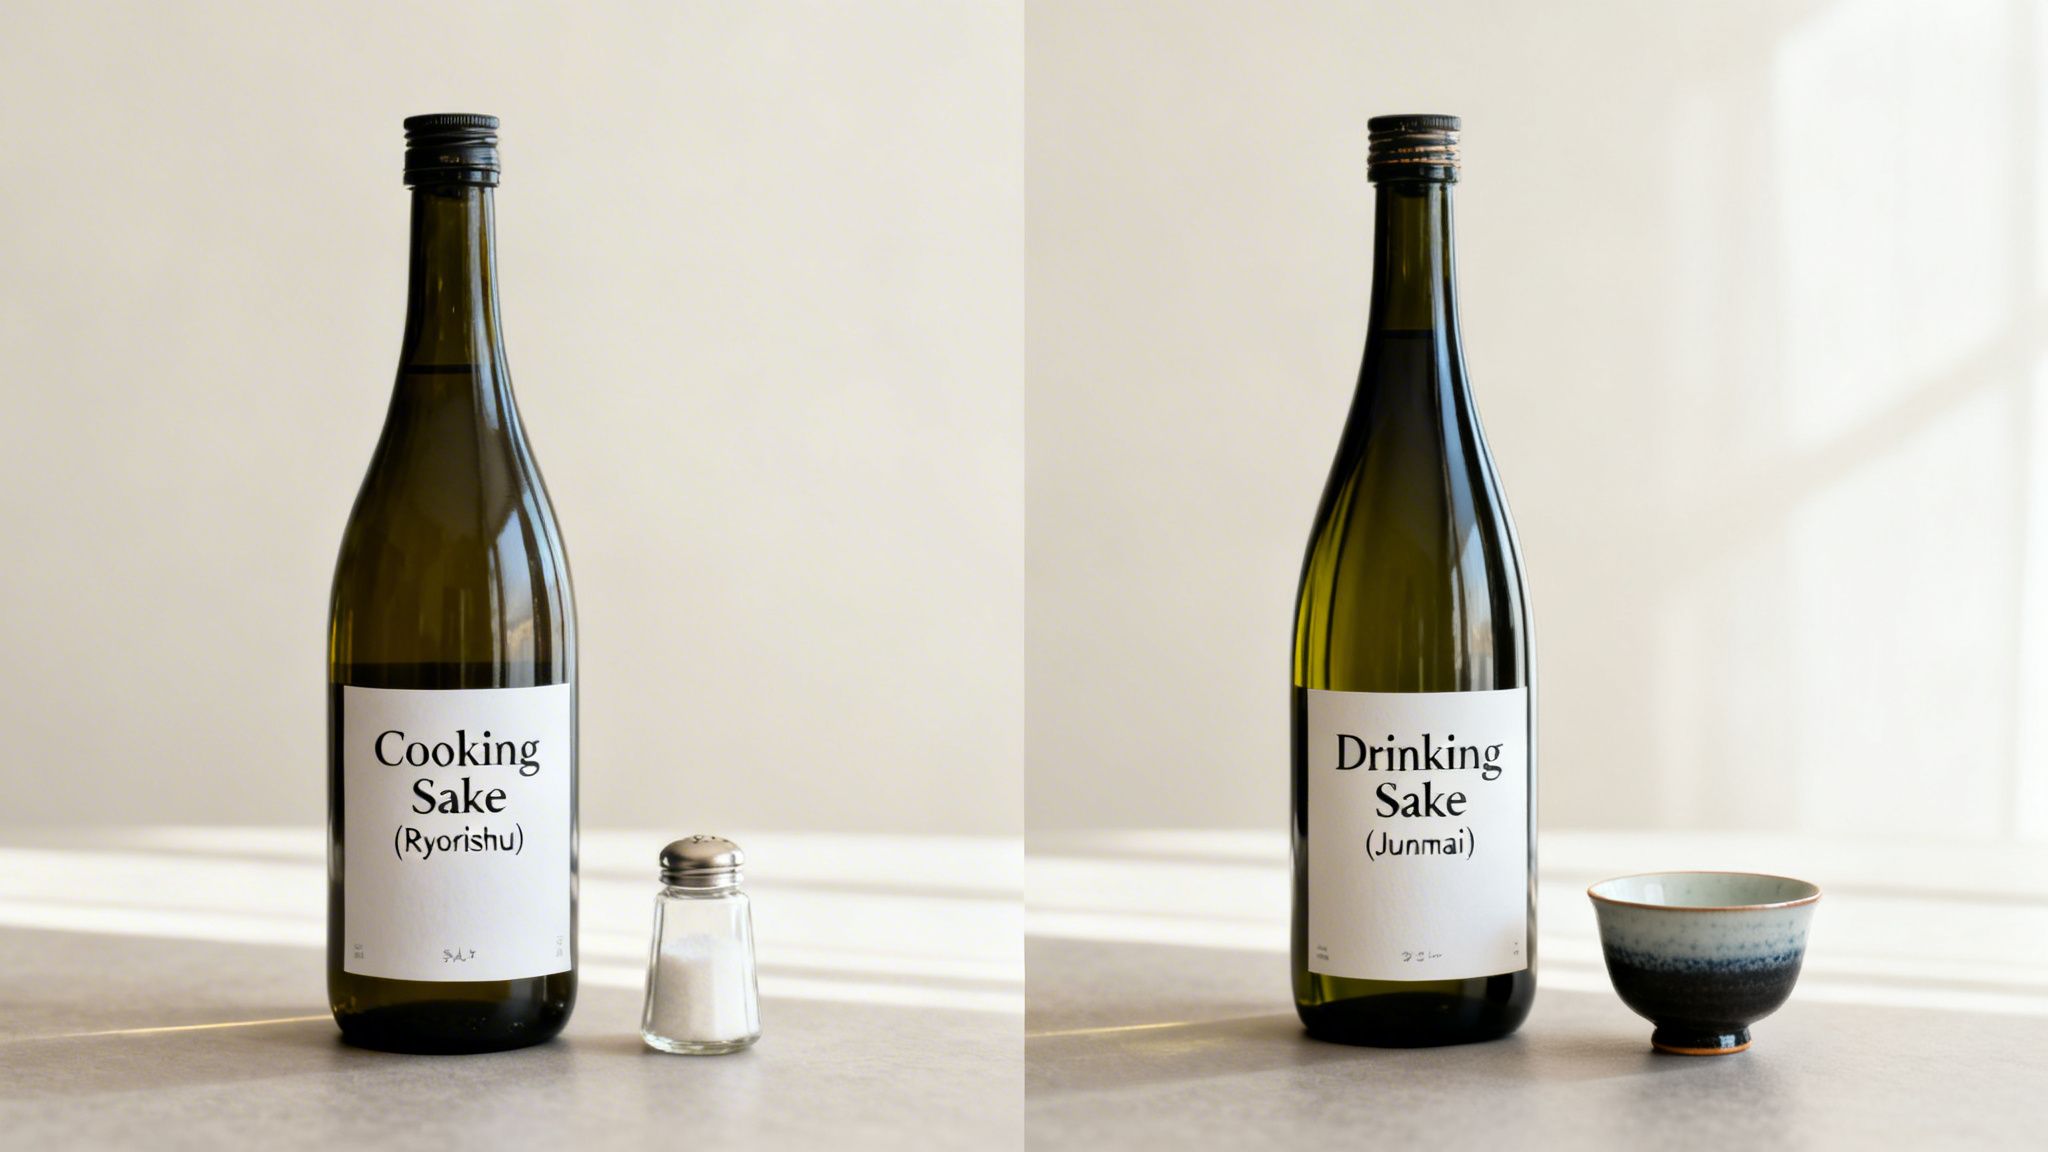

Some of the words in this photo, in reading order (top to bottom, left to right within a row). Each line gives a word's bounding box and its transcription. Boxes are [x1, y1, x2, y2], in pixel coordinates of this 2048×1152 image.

[374, 729, 541, 778] Cooking
[1335, 733, 1504, 782] Drinking
[411, 776, 507, 815] Sake
[1375, 780, 1468, 819] Sake
[394, 823, 524, 862] (Ryorishu)
[1365, 826, 1475, 862] (Junmai)
